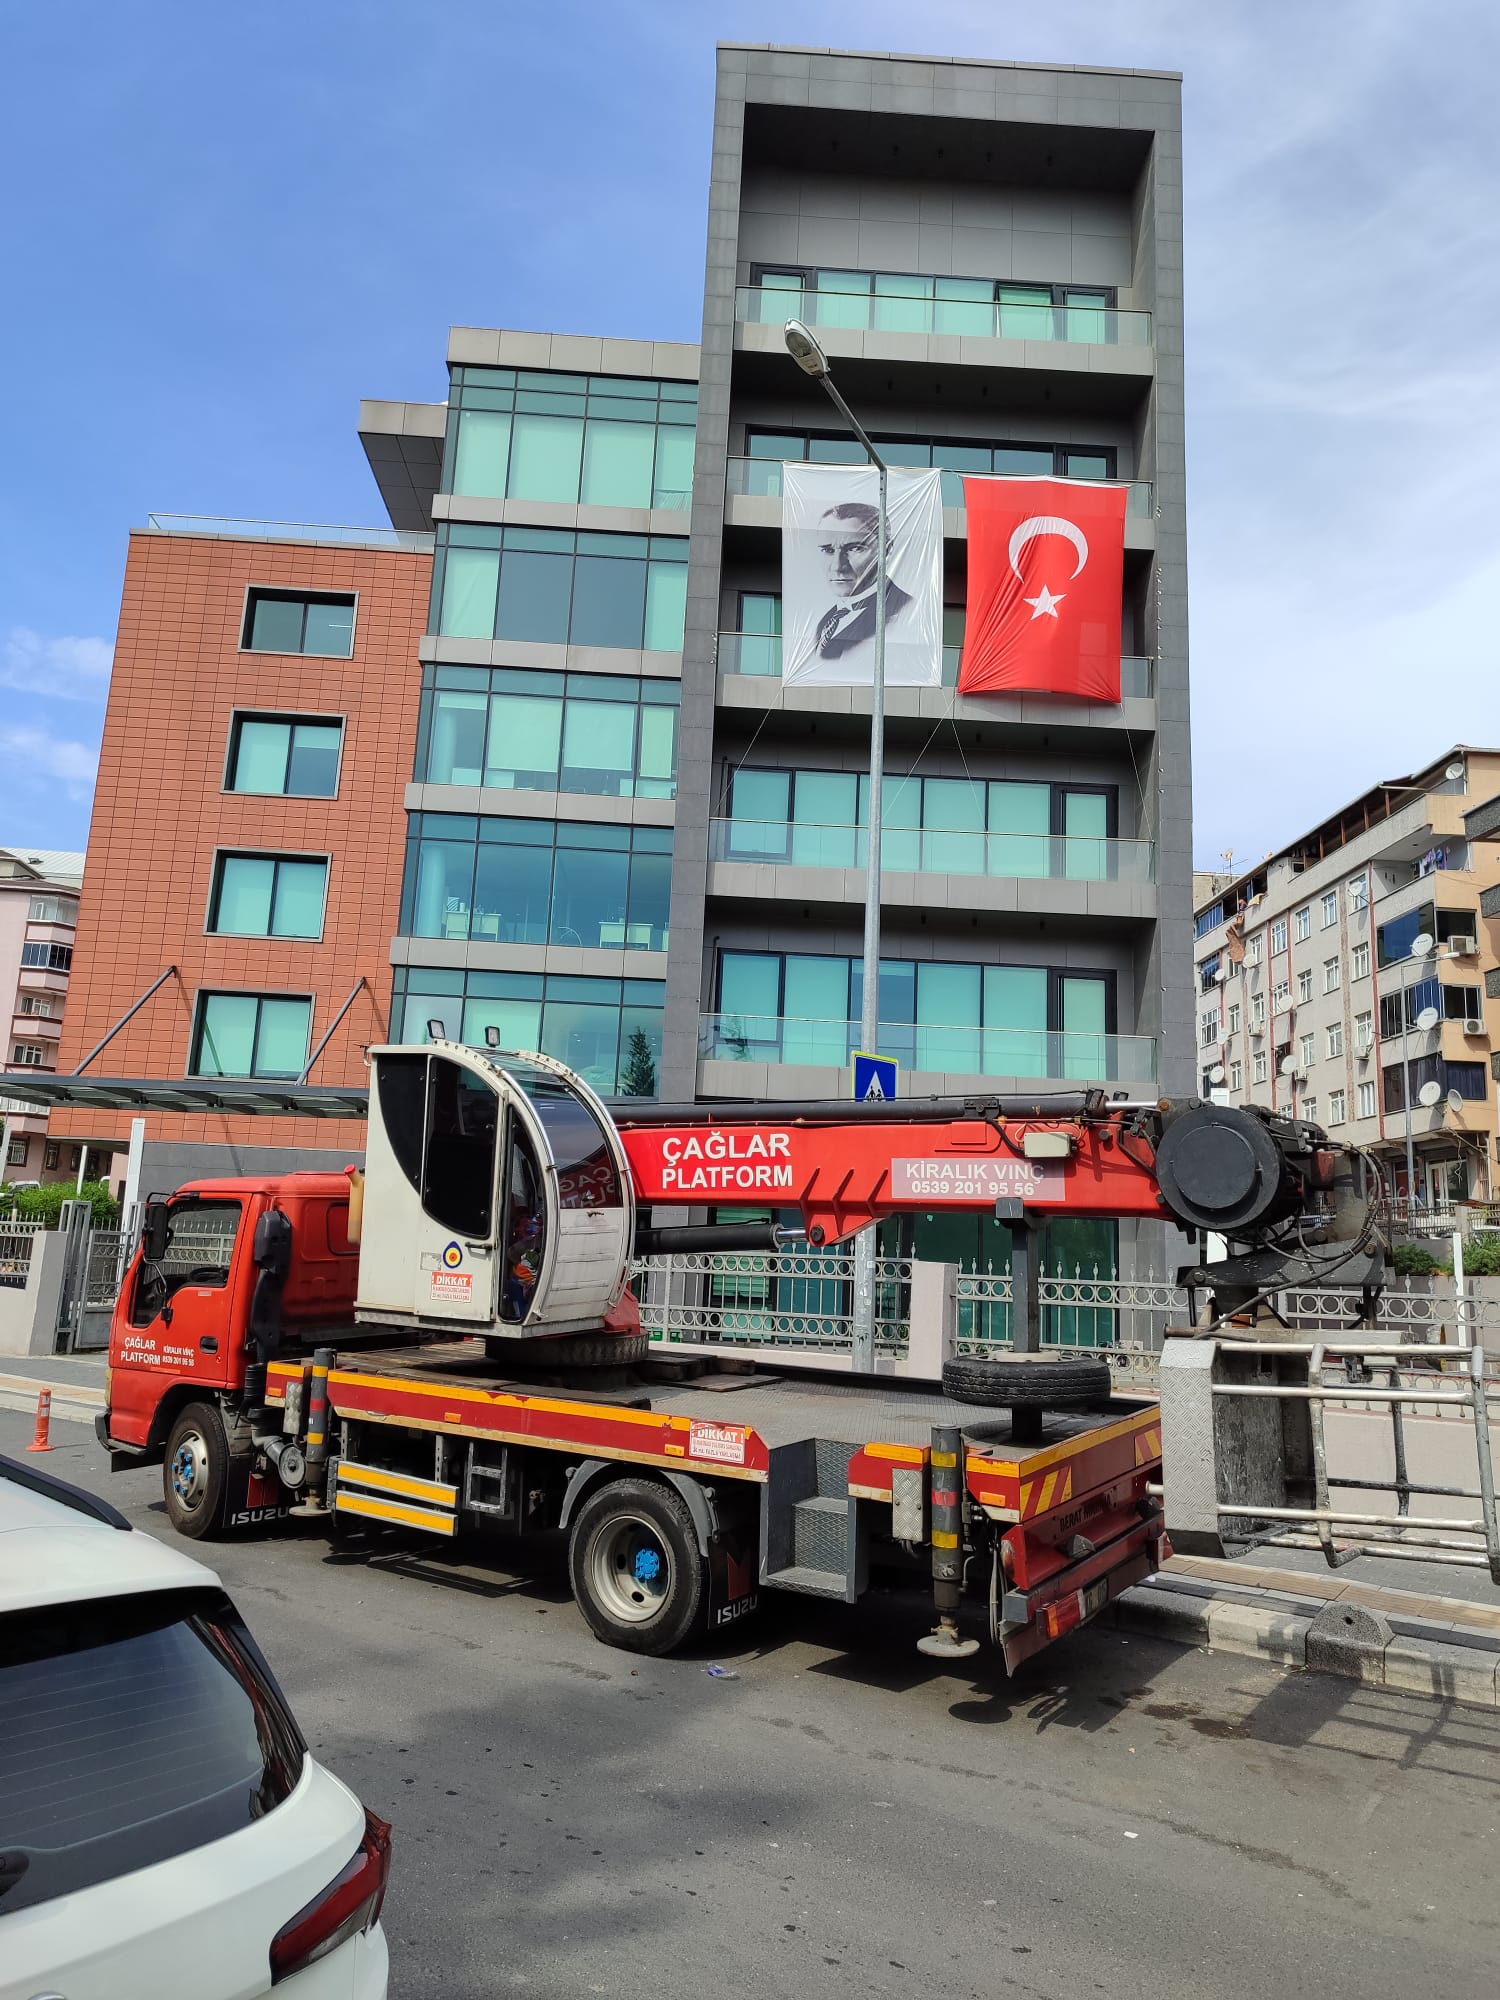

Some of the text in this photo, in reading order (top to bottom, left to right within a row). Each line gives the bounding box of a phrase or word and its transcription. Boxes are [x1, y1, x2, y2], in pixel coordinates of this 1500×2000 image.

[662, 1130, 791, 1167] ÇAĞLAR
[662, 1165, 793, 1189] PLATFORM
[906, 1160, 988, 1179] KİRALIK
[911, 1180, 1034, 1196] 0539 201 95 56
[124, 1336, 156, 1351] ÇAĞLAR
[120, 1350, 160, 1366] PLATFORM
[231, 1505, 289, 1525] ISUZU
[717, 1593, 758, 1625] ISUZU
